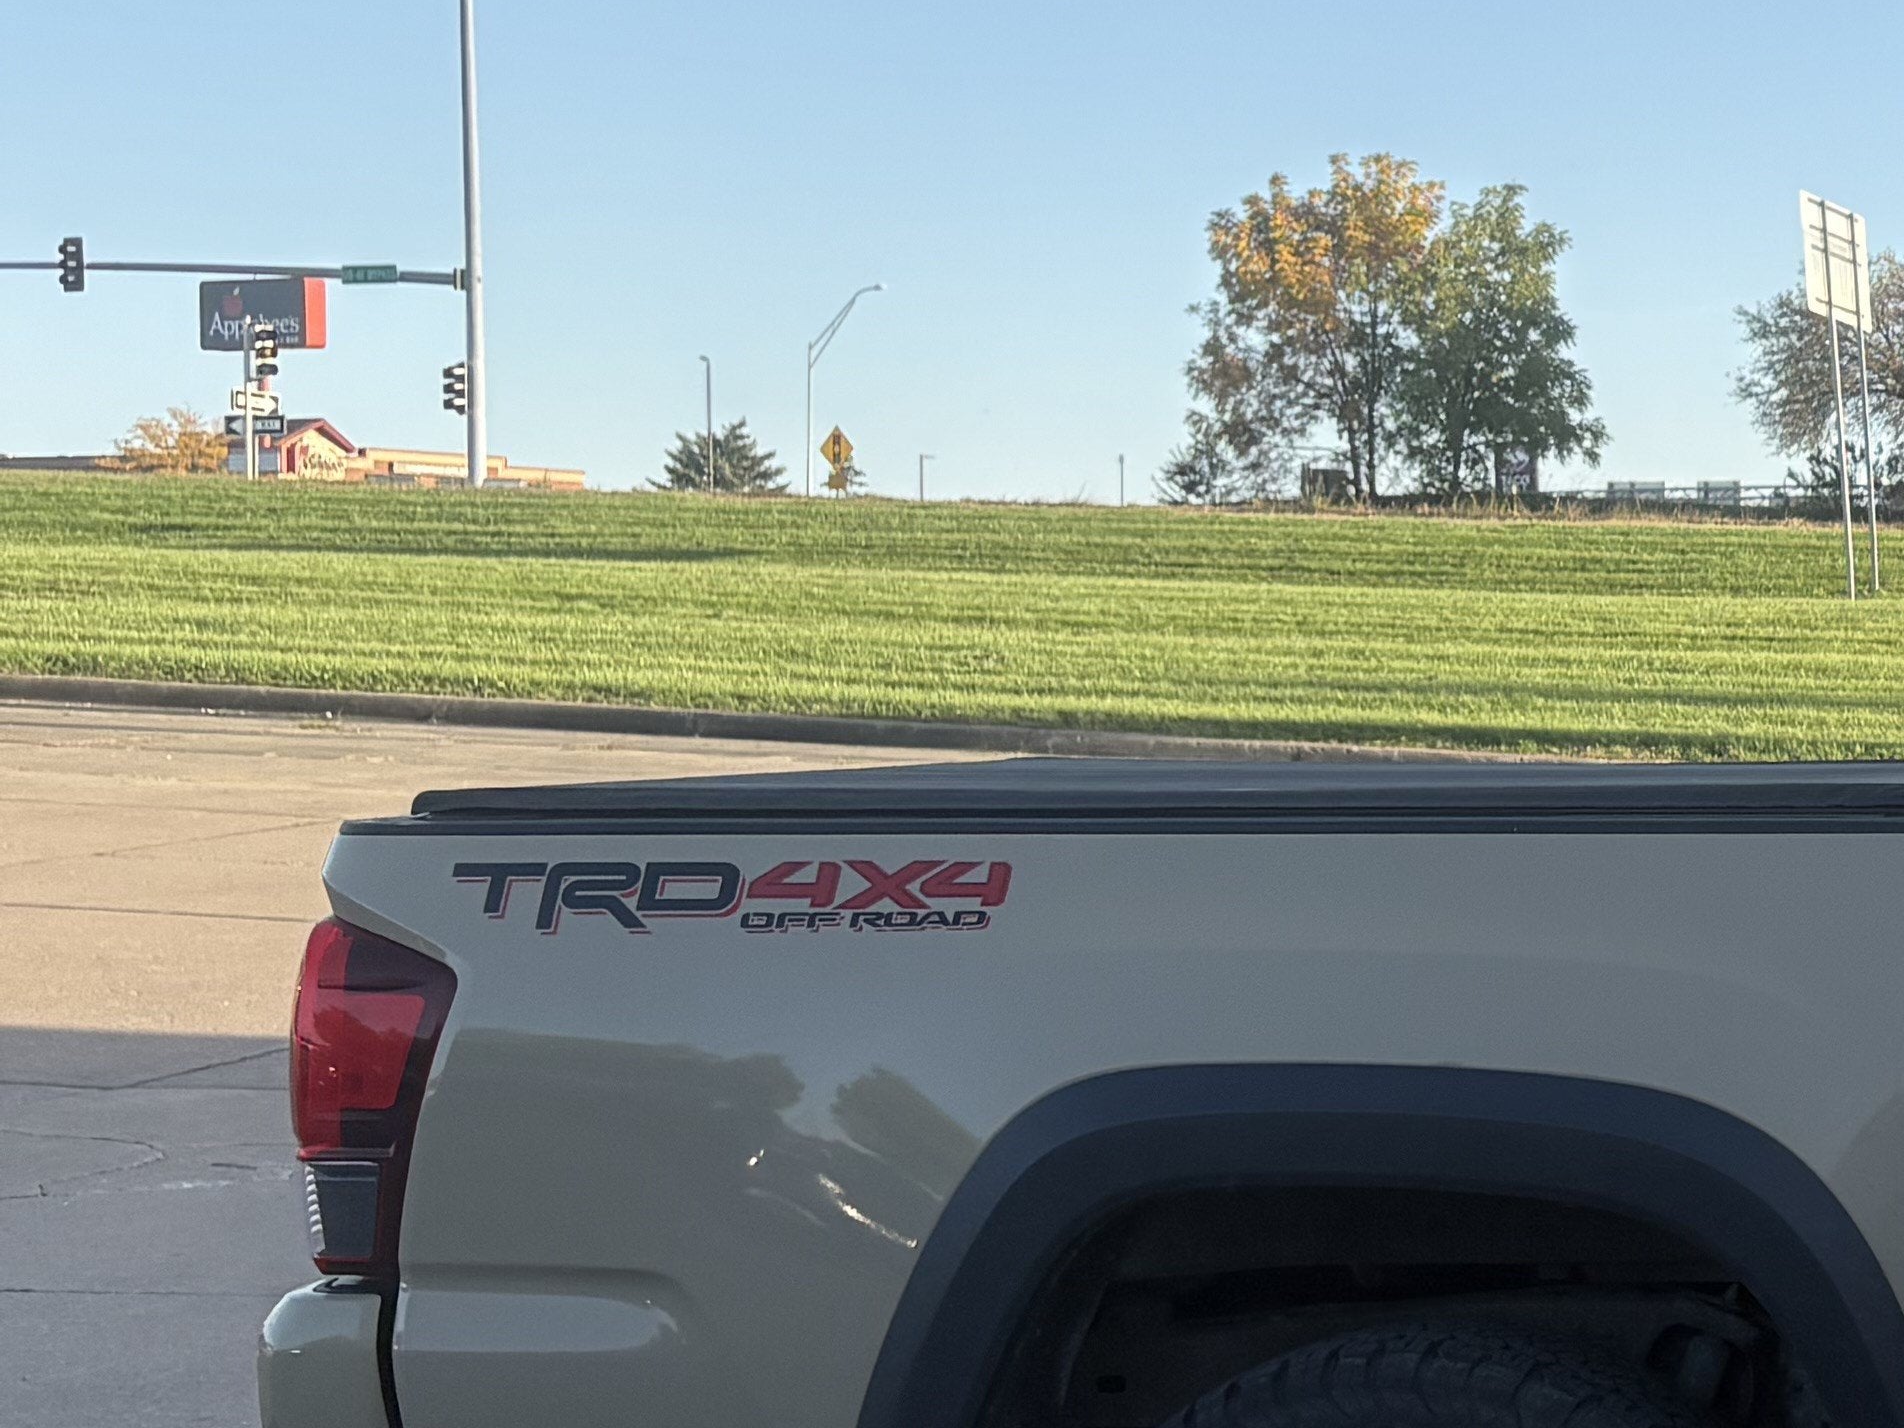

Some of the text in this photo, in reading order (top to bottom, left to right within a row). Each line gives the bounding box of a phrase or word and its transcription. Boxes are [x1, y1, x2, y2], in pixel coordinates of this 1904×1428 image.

[452, 860, 746, 934] TRD
[740, 909, 993, 933] OFF ROAD
